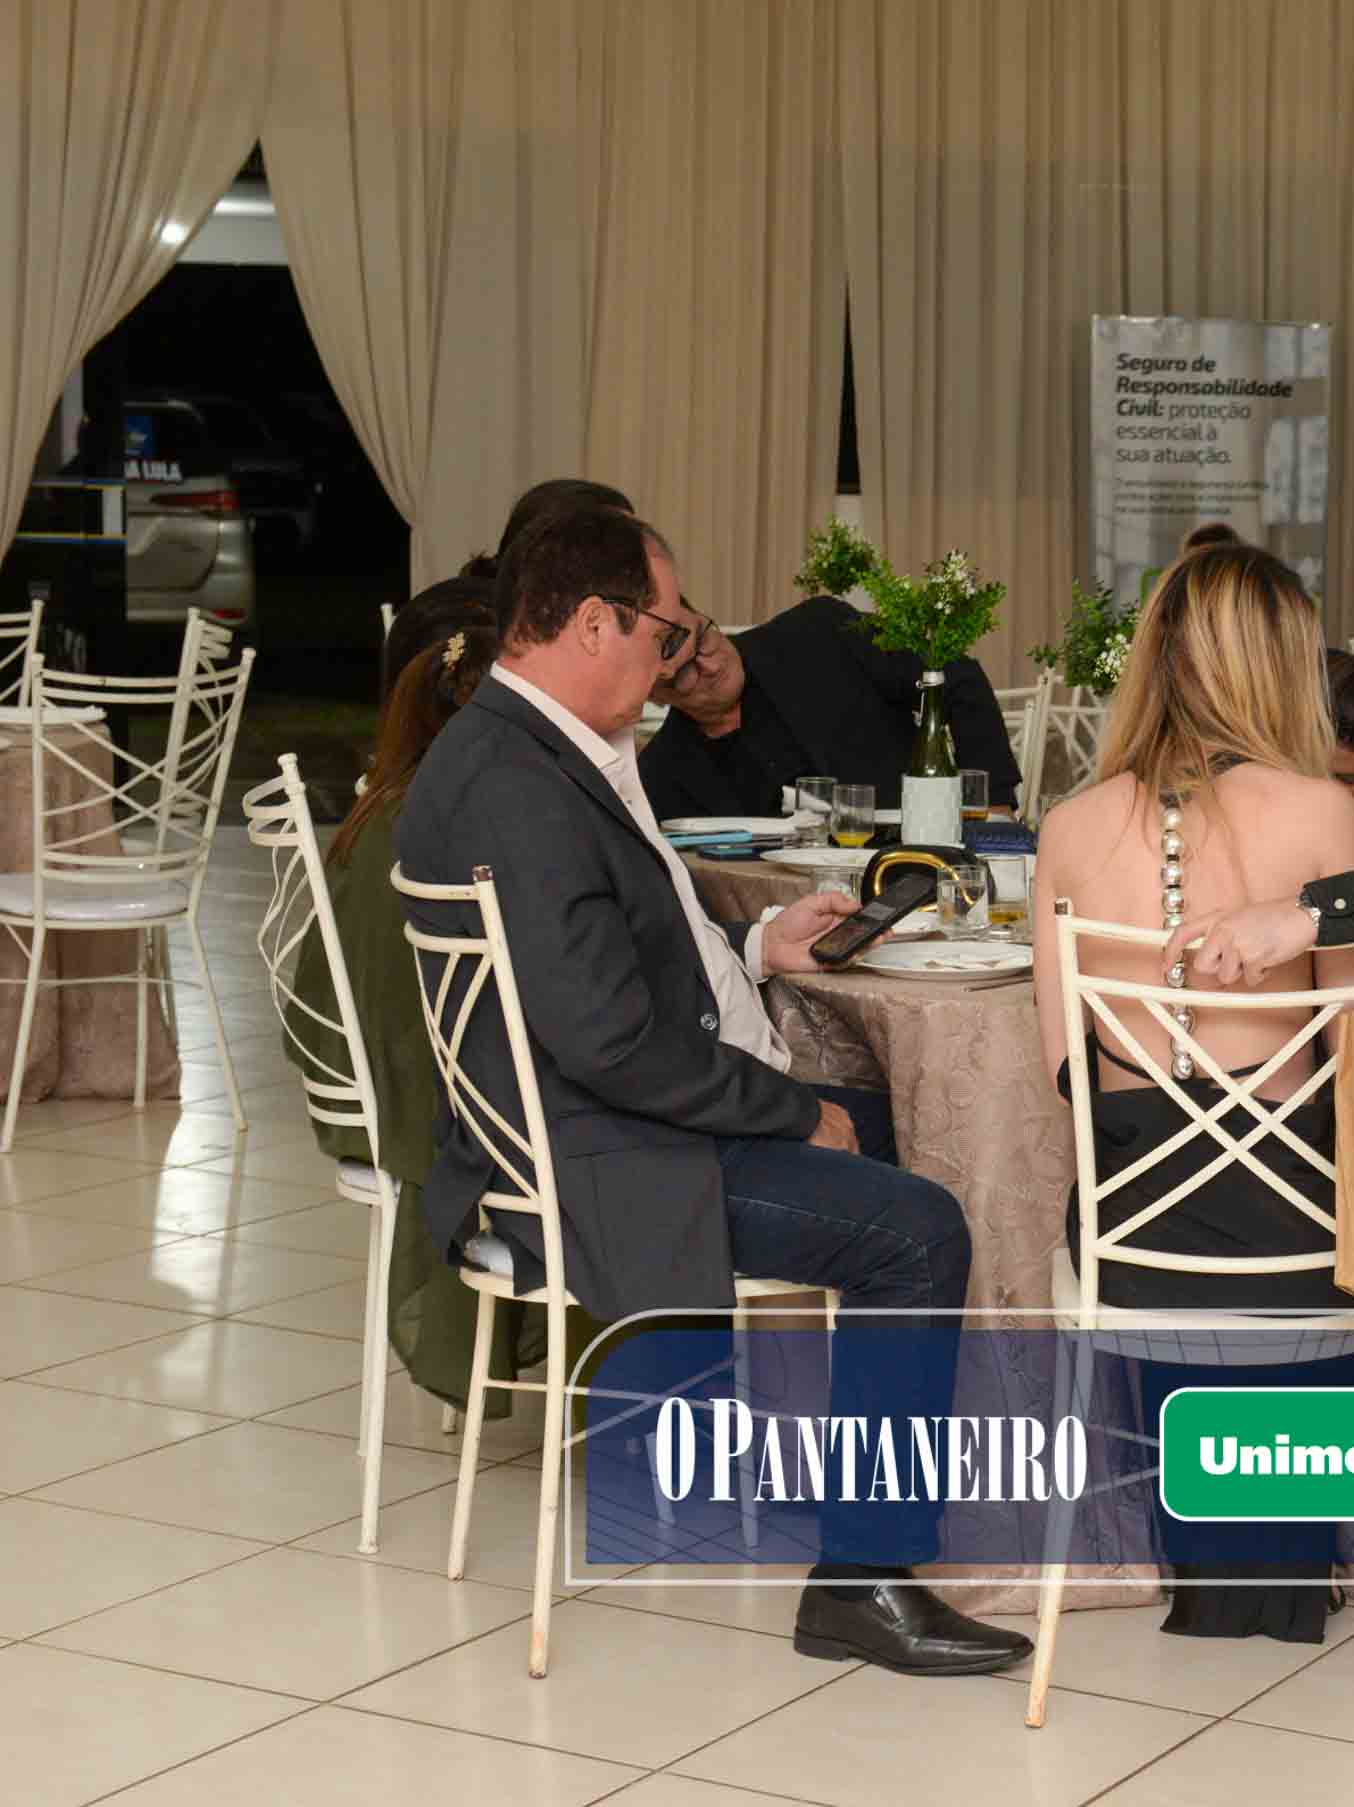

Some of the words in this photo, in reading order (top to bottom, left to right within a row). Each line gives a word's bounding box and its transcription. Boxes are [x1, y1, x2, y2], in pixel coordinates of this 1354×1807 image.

[1116, 353, 1188, 375] Seguro
[1192, 355, 1217, 373] de
[1115, 376, 1293, 399] Responsabilidade
[1116, 398, 1164, 417] Civil:
[1168, 402, 1252, 424] proteção
[1116, 422, 1202, 441] essencial
[1116, 447, 1149, 463] sua
